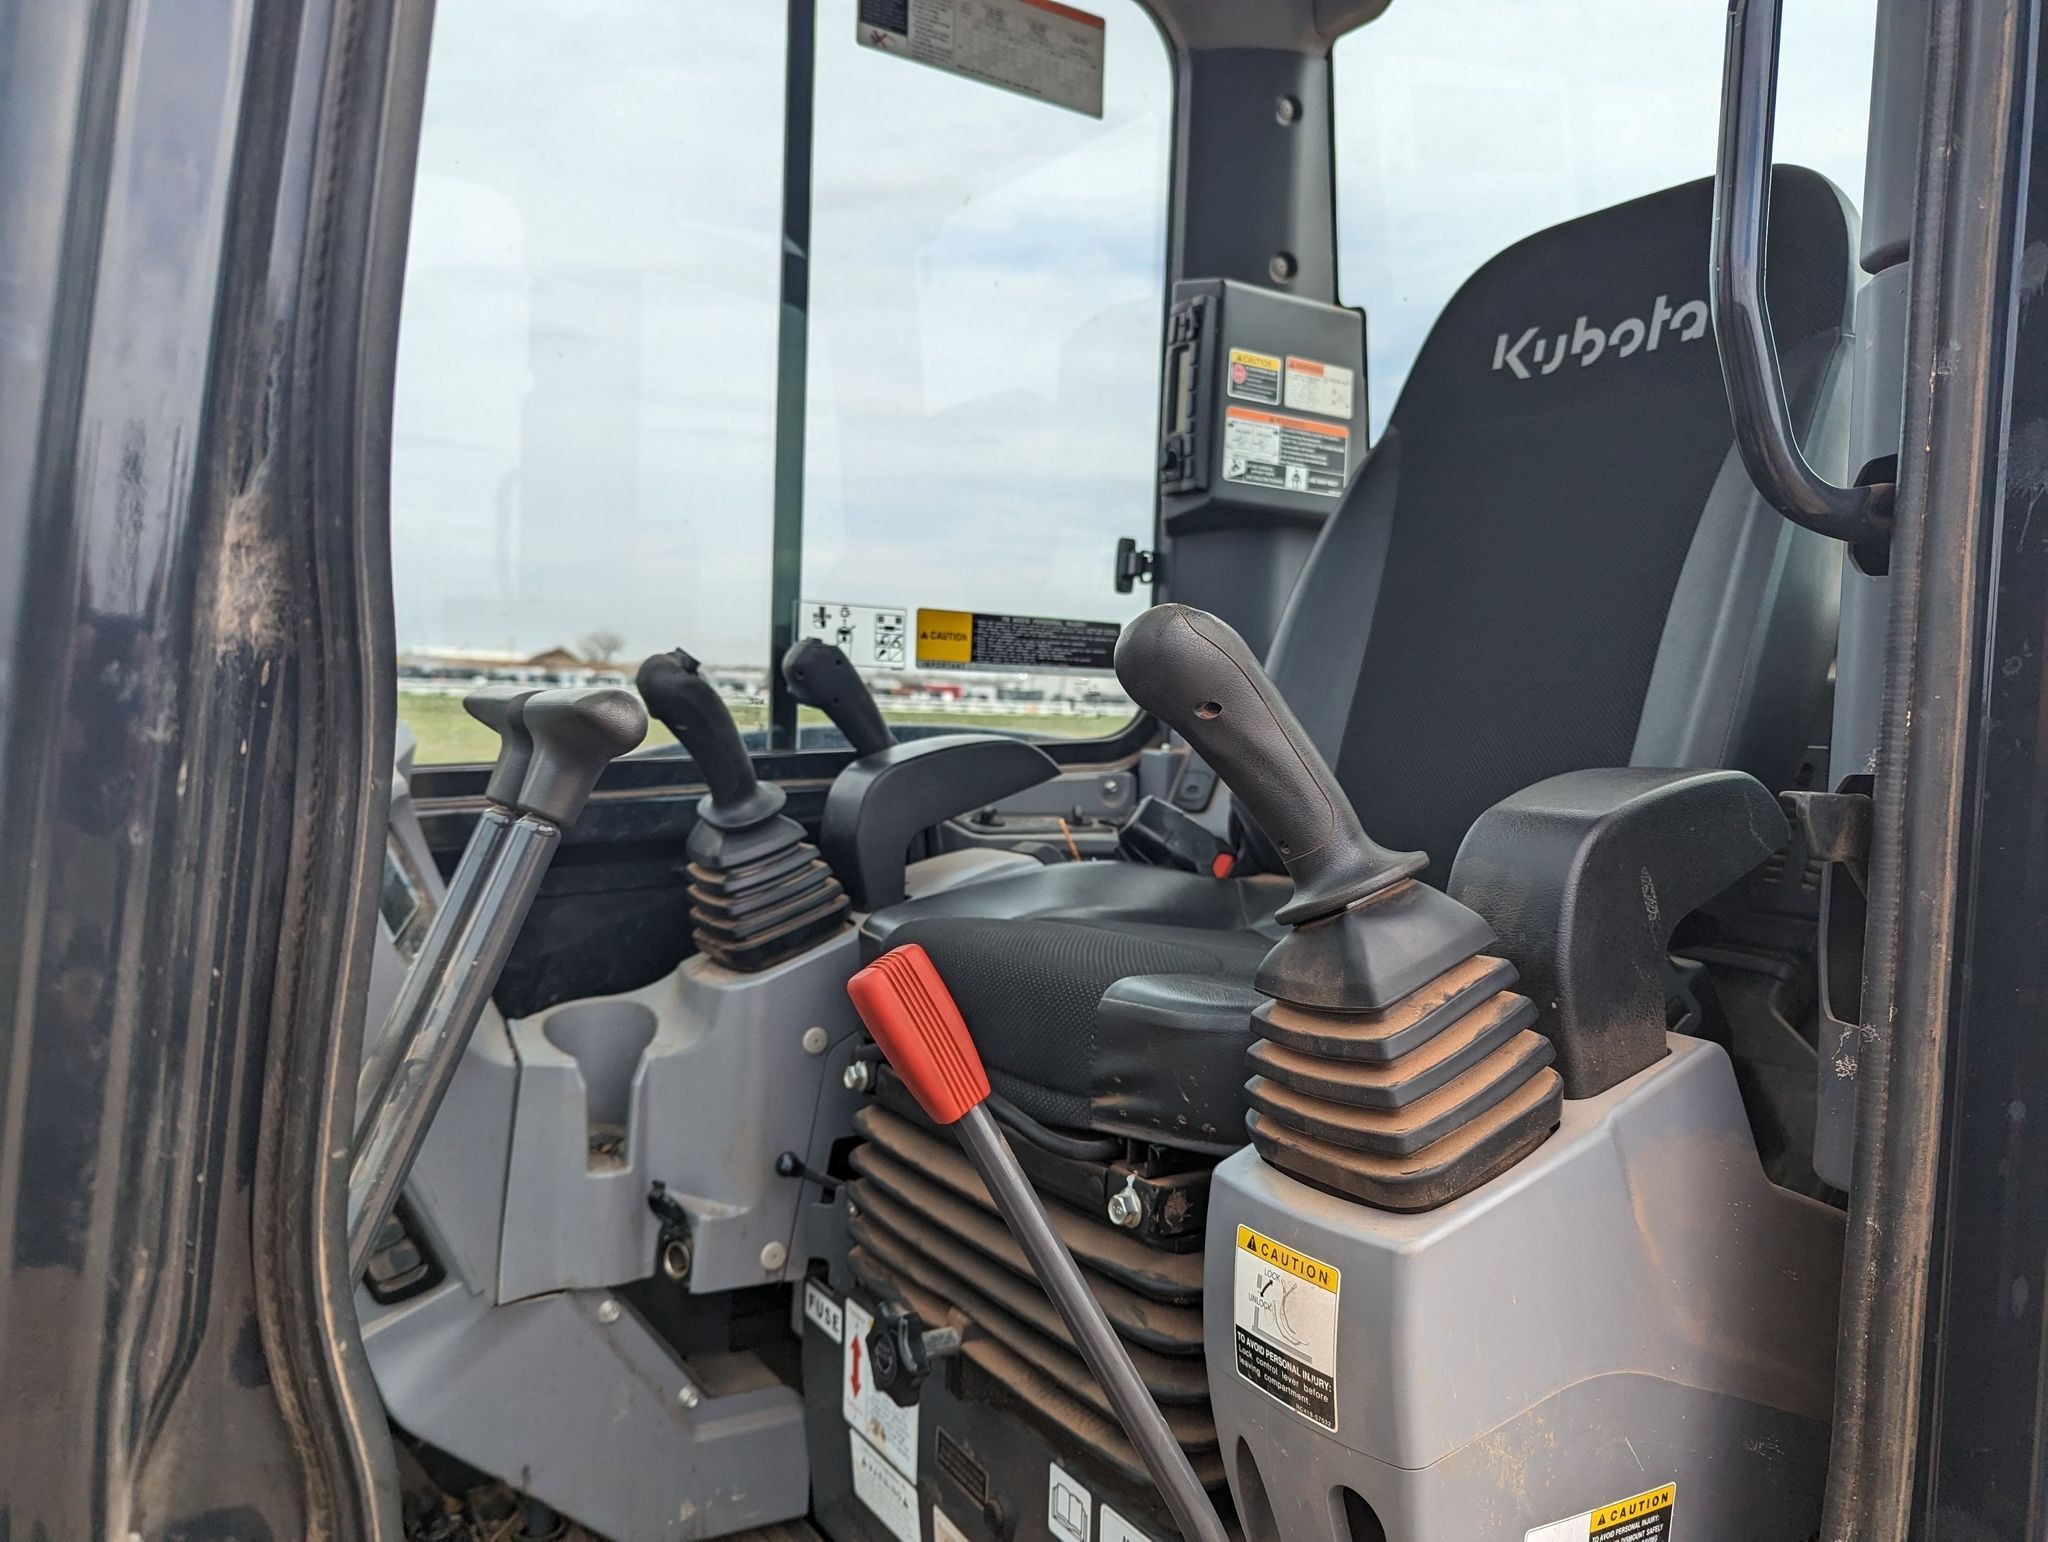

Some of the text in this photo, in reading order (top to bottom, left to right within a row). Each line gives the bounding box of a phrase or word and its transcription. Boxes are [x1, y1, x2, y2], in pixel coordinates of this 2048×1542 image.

[1491, 294, 1709, 380] Kubota
[930, 630, 968, 642] CAUTION
[1261, 1243, 1328, 1286] CAUTION
[1264, 1267, 1280, 1281] LOCK
[808, 1293, 840, 1334] FUSE
[1248, 1292, 1272, 1311] UNLOCK
[1237, 1331, 1332, 1393] TO AVOID PERSONAL INJURY:
[1238, 1343, 1329, 1403] Lock control lever before
[1238, 1355, 1311, 1406] leaving compartment.
[1610, 1492, 1669, 1521] CAUTION
[1599, 1530, 1615, 1542] AVOID
[1615, 1523, 1641, 1537] PERSONAL
[1641, 1514, 1660, 1527] INJURY:
[1646, 1523, 1664, 1537] SAFELY
